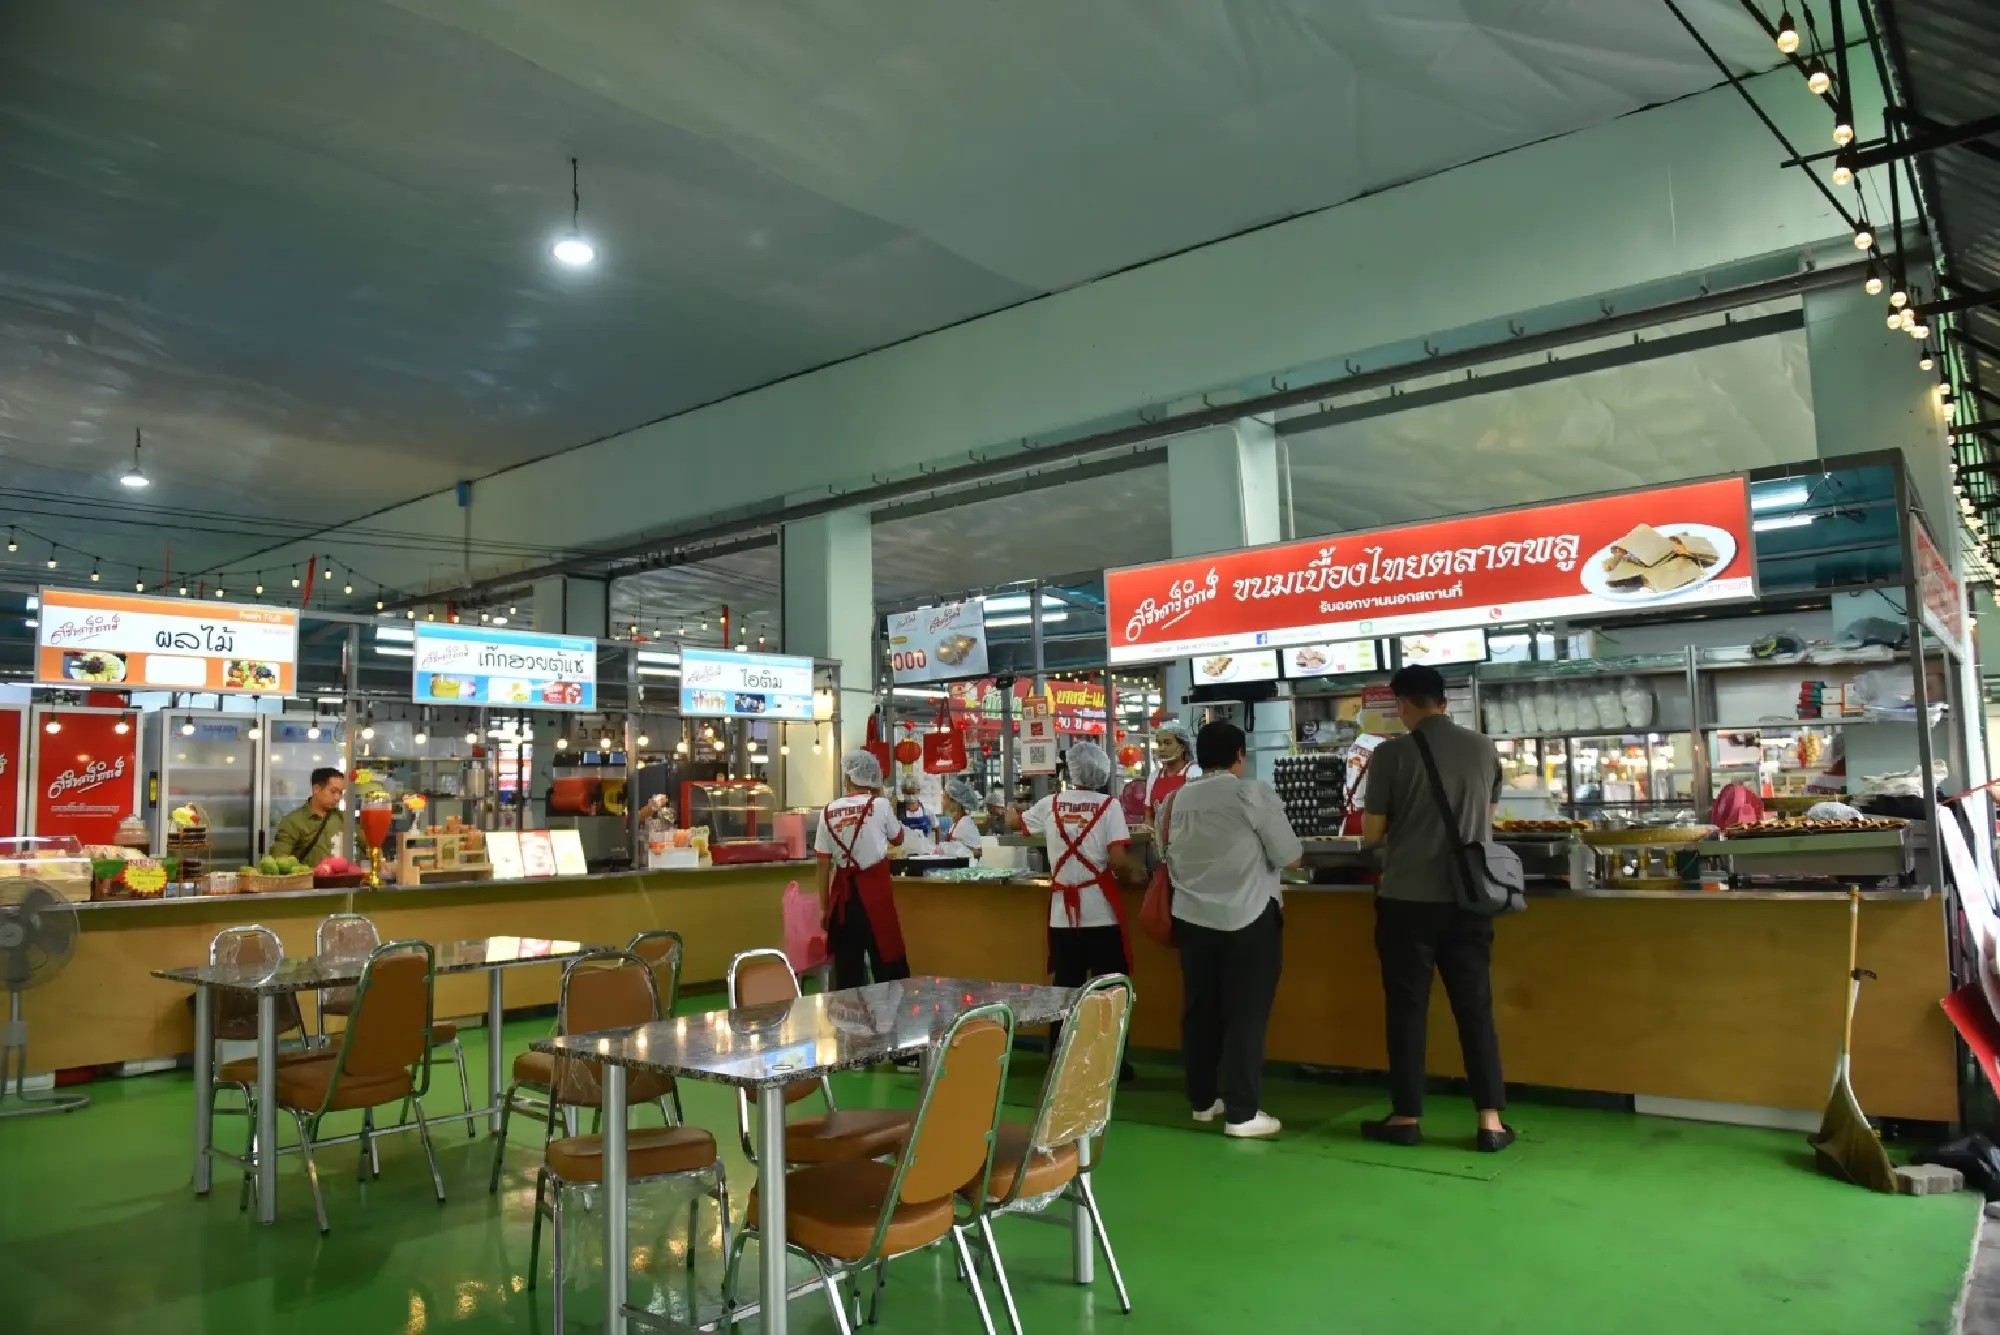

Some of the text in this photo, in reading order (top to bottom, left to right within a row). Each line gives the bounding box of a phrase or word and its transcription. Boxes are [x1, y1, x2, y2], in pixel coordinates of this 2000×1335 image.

[1232, 533, 1581, 602] ขนมเบื้องไทยตลาดพลู
[1318, 580, 1463, 614] รับออกงานนอกสถานที่
[155, 623, 236, 652] ผลไม้
[740, 668, 782, 689] ไอติม
